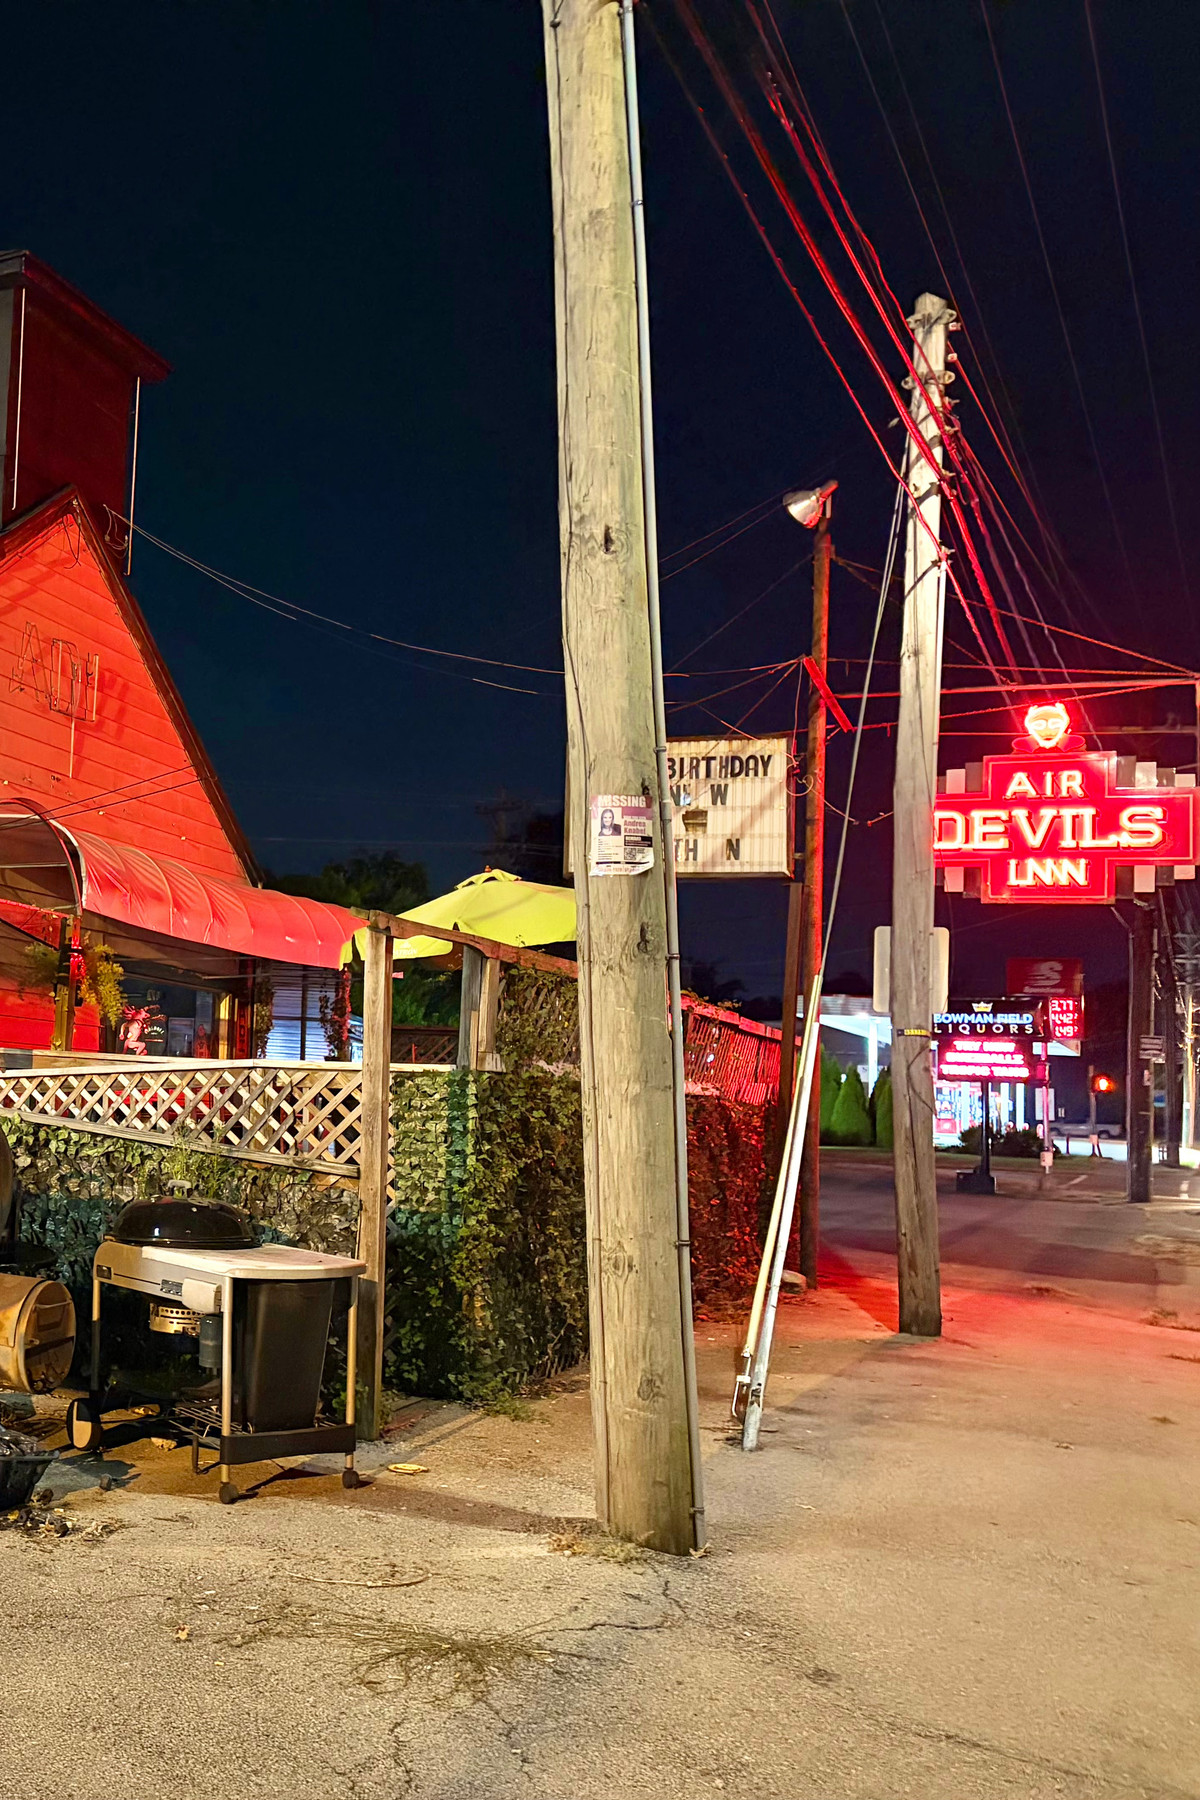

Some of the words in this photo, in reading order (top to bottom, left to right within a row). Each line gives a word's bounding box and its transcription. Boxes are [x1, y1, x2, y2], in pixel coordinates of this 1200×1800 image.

[1002, 770, 1086, 800] AIR
[597, 795, 647, 808] MISSING
[933, 806, 1167, 850] DEVILS
[1007, 858, 1090, 888] INN
[933, 1013, 994, 1024] BOWMAN
[995, 1013, 1034, 1025] FIELD
[933, 1024, 1034, 1034] LIQUORS
